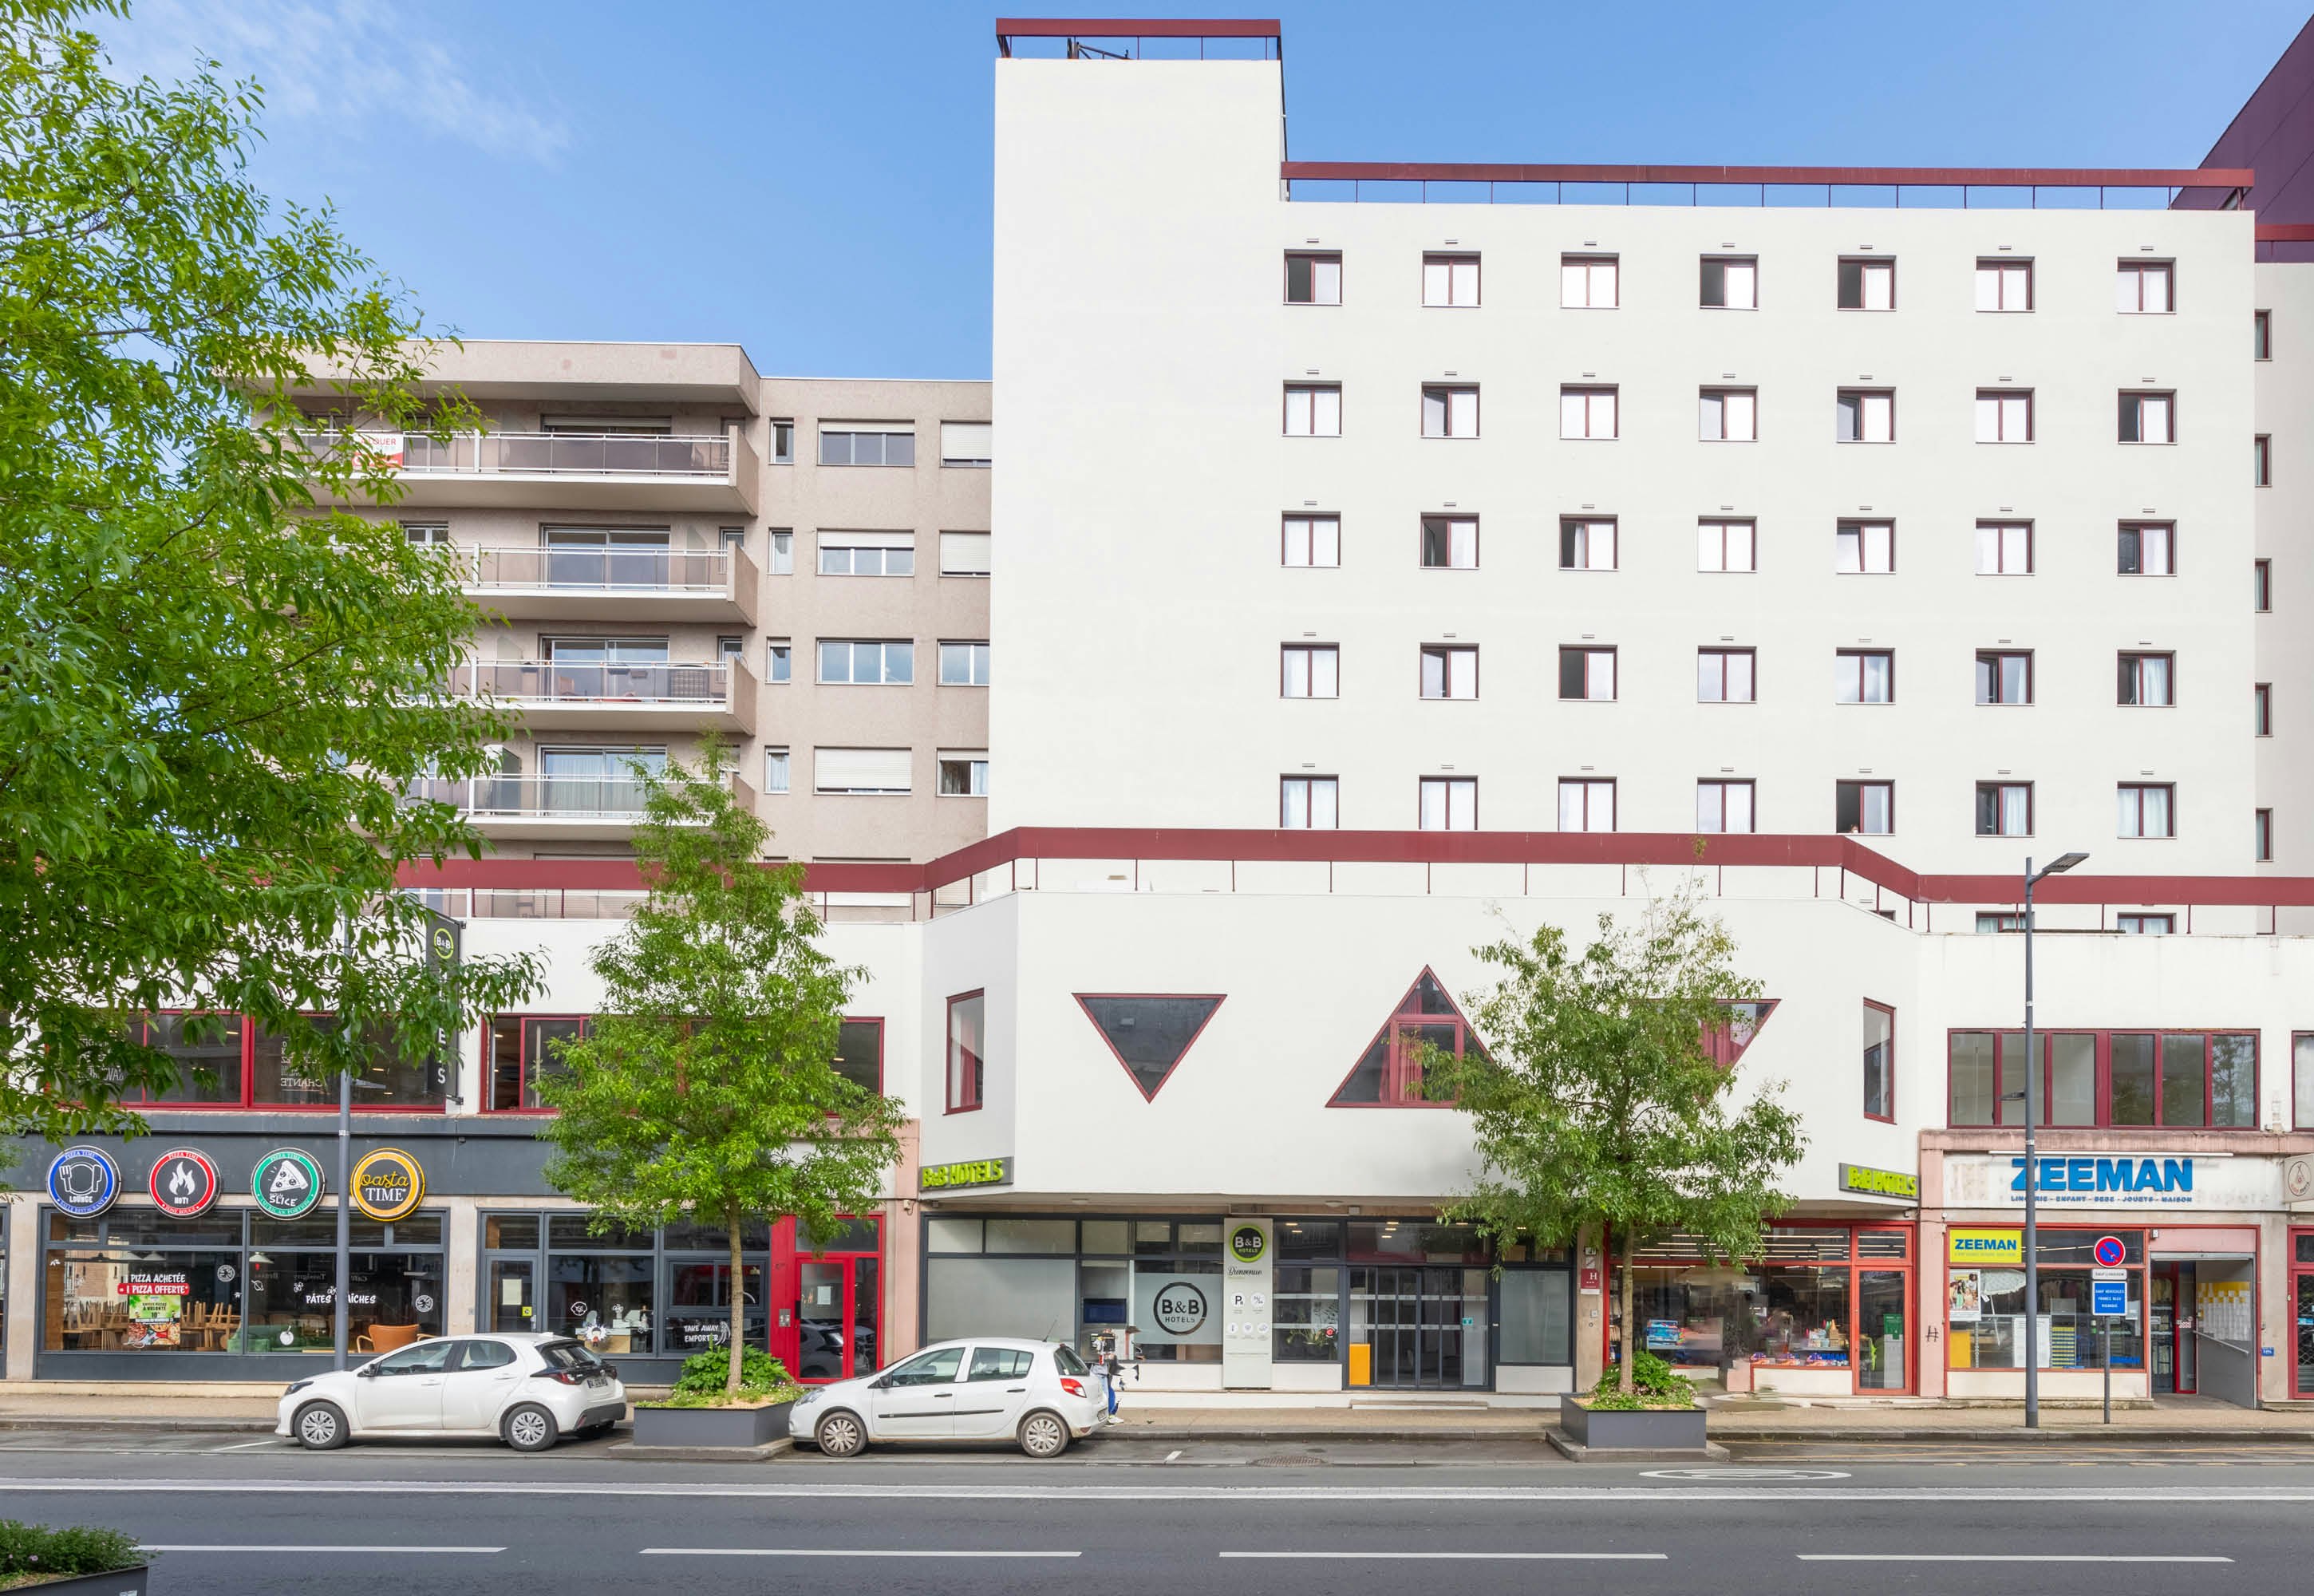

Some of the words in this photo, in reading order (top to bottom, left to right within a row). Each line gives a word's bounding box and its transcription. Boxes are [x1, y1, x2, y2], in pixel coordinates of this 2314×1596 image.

[361, 1171, 409, 1188] pasta
[922, 1167, 948, 1187] B&B
[950, 1159, 1004, 1184] HOTELS
[2011, 1158, 2193, 1191] ZEEMAN
[1873, 1170, 1917, 1195] HOTELS
[269, 1195, 298, 1207] SLICE
[365, 1187, 404, 1202] TIME
[1235, 1236, 1262, 1248] B&B
[1955, 1238, 2017, 1250] ZEEMAN
[130, 1274, 152, 1282] PIZZA
[153, 1272, 186, 1283] ACHETÉE
[132, 1285, 152, 1294] PIZZA
[1162, 1299, 1200, 1314] B&B
